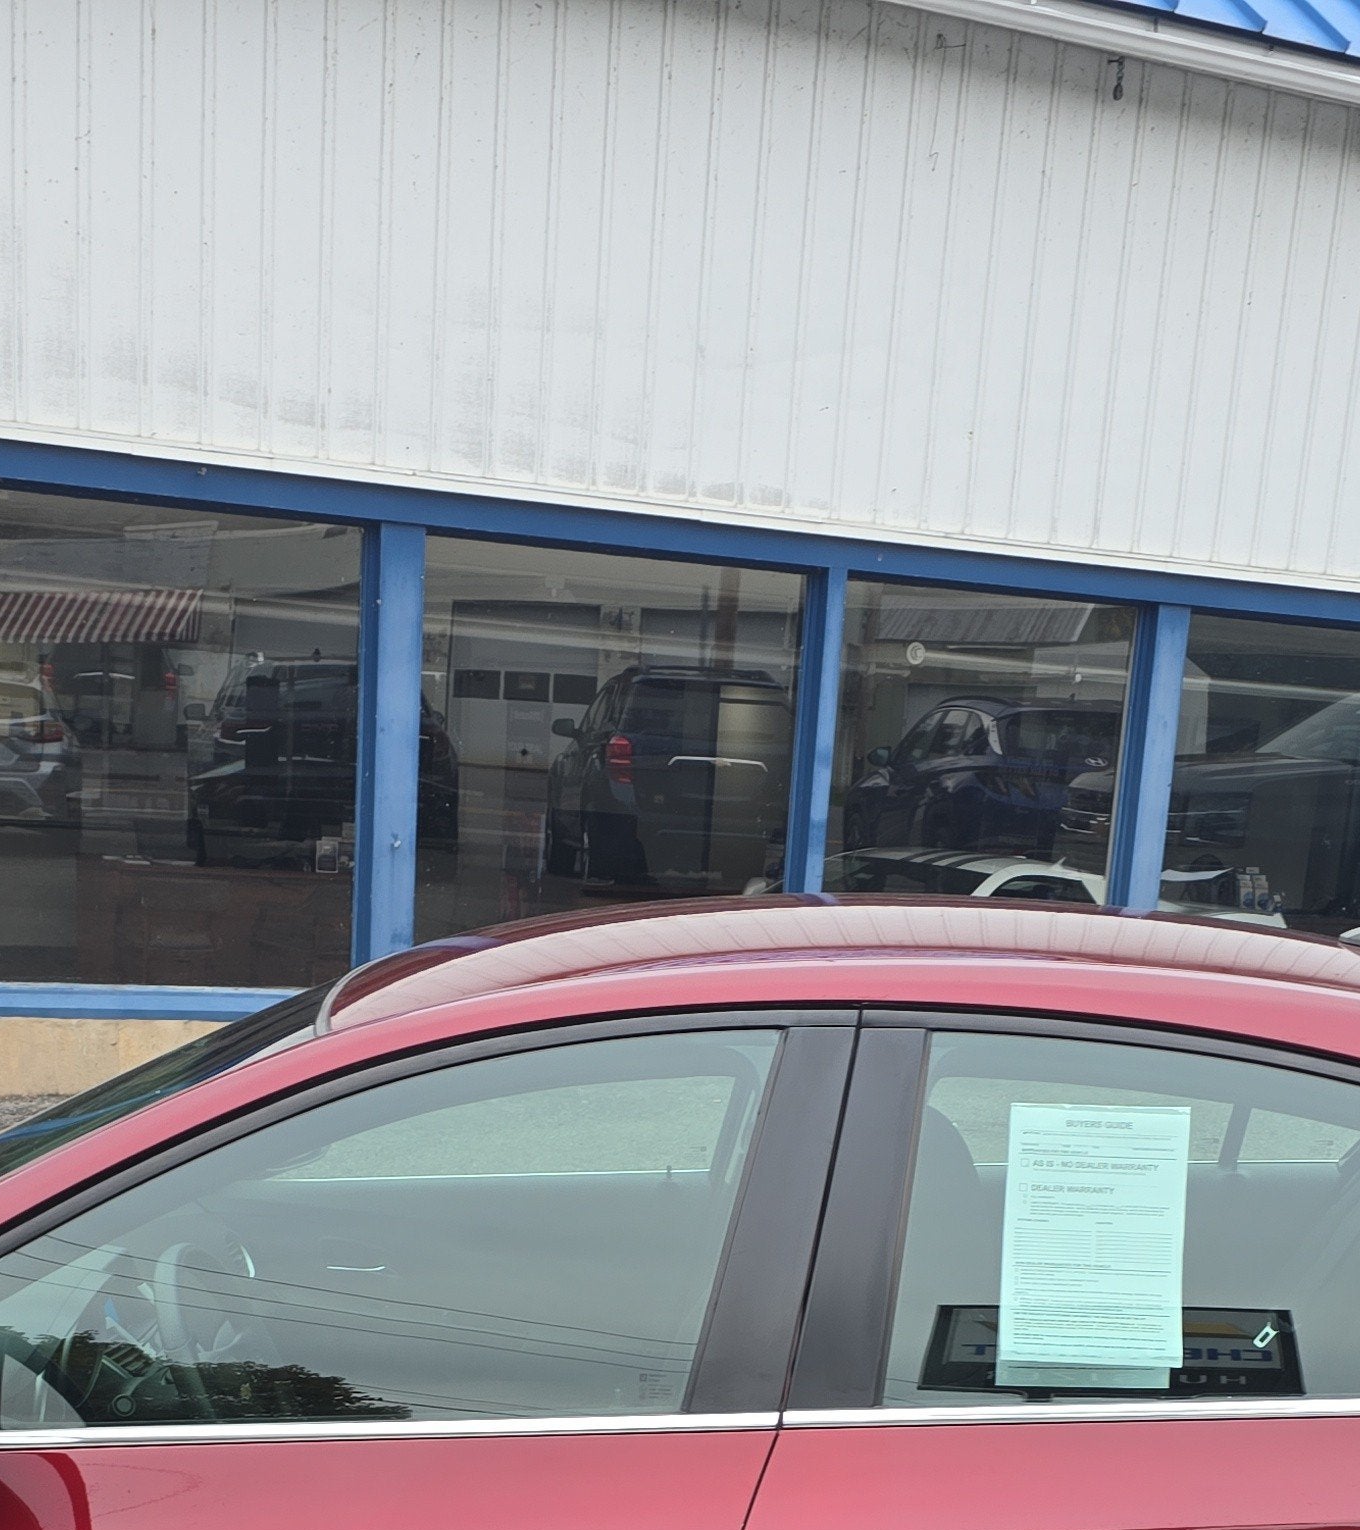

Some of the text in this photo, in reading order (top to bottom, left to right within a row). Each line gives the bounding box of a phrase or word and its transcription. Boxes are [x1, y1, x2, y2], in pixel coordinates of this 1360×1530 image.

[1065, 1119, 1134, 1130] BUYERS GUIDE
[1032, 1159, 1044, 1168] AS
[1045, 1160, 1054, 1168] IS
[1060, 1160, 1074, 1169] NO
[1075, 1161, 1109, 1170] DEALER
[1110, 1163, 1160, 1172] WARRANTY
[1030, 1183, 1115, 1195] DEALER WARRANTY
